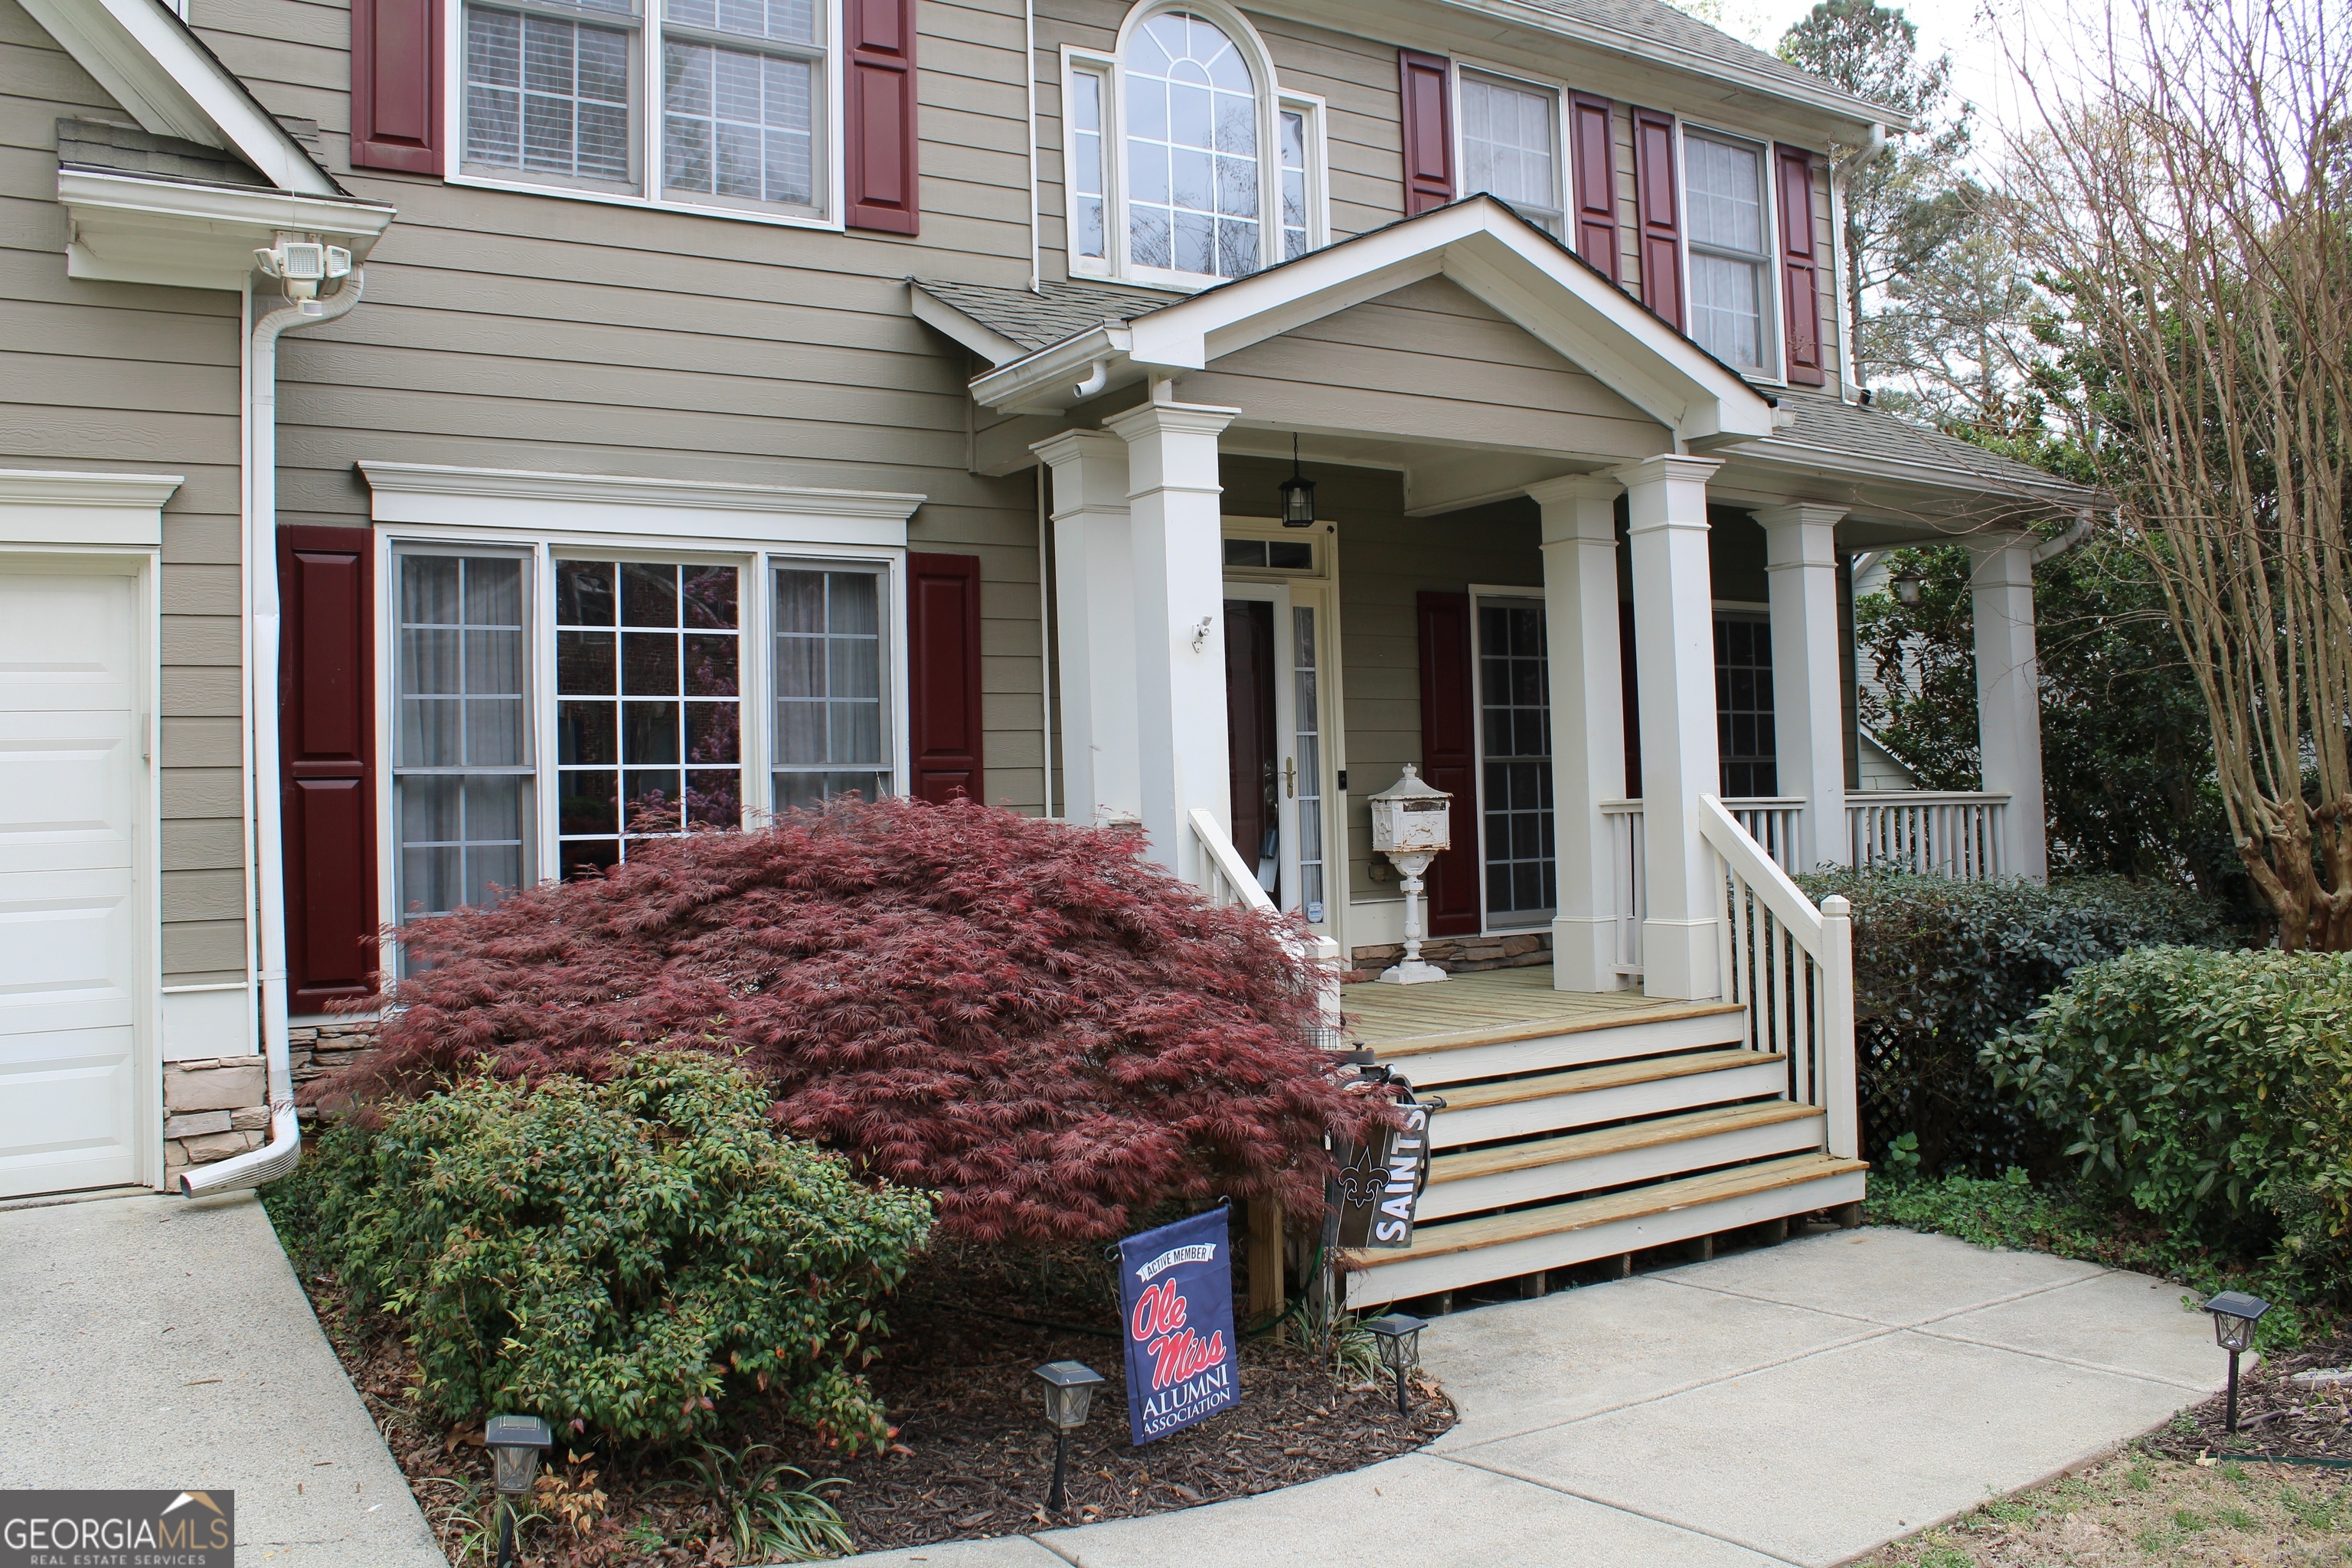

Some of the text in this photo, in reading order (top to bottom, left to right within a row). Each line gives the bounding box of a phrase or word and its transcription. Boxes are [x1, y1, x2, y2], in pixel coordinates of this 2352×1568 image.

[1148, 1246, 1207, 1277] ACTIVE MEMBER
[1132, 1277, 1187, 1341] Ole
[1148, 1327, 1227, 1390] Miss
[1142, 1363, 1230, 1421] ALUMNI
[1142, 1387, 1230, 1437] ASSOCIATION
